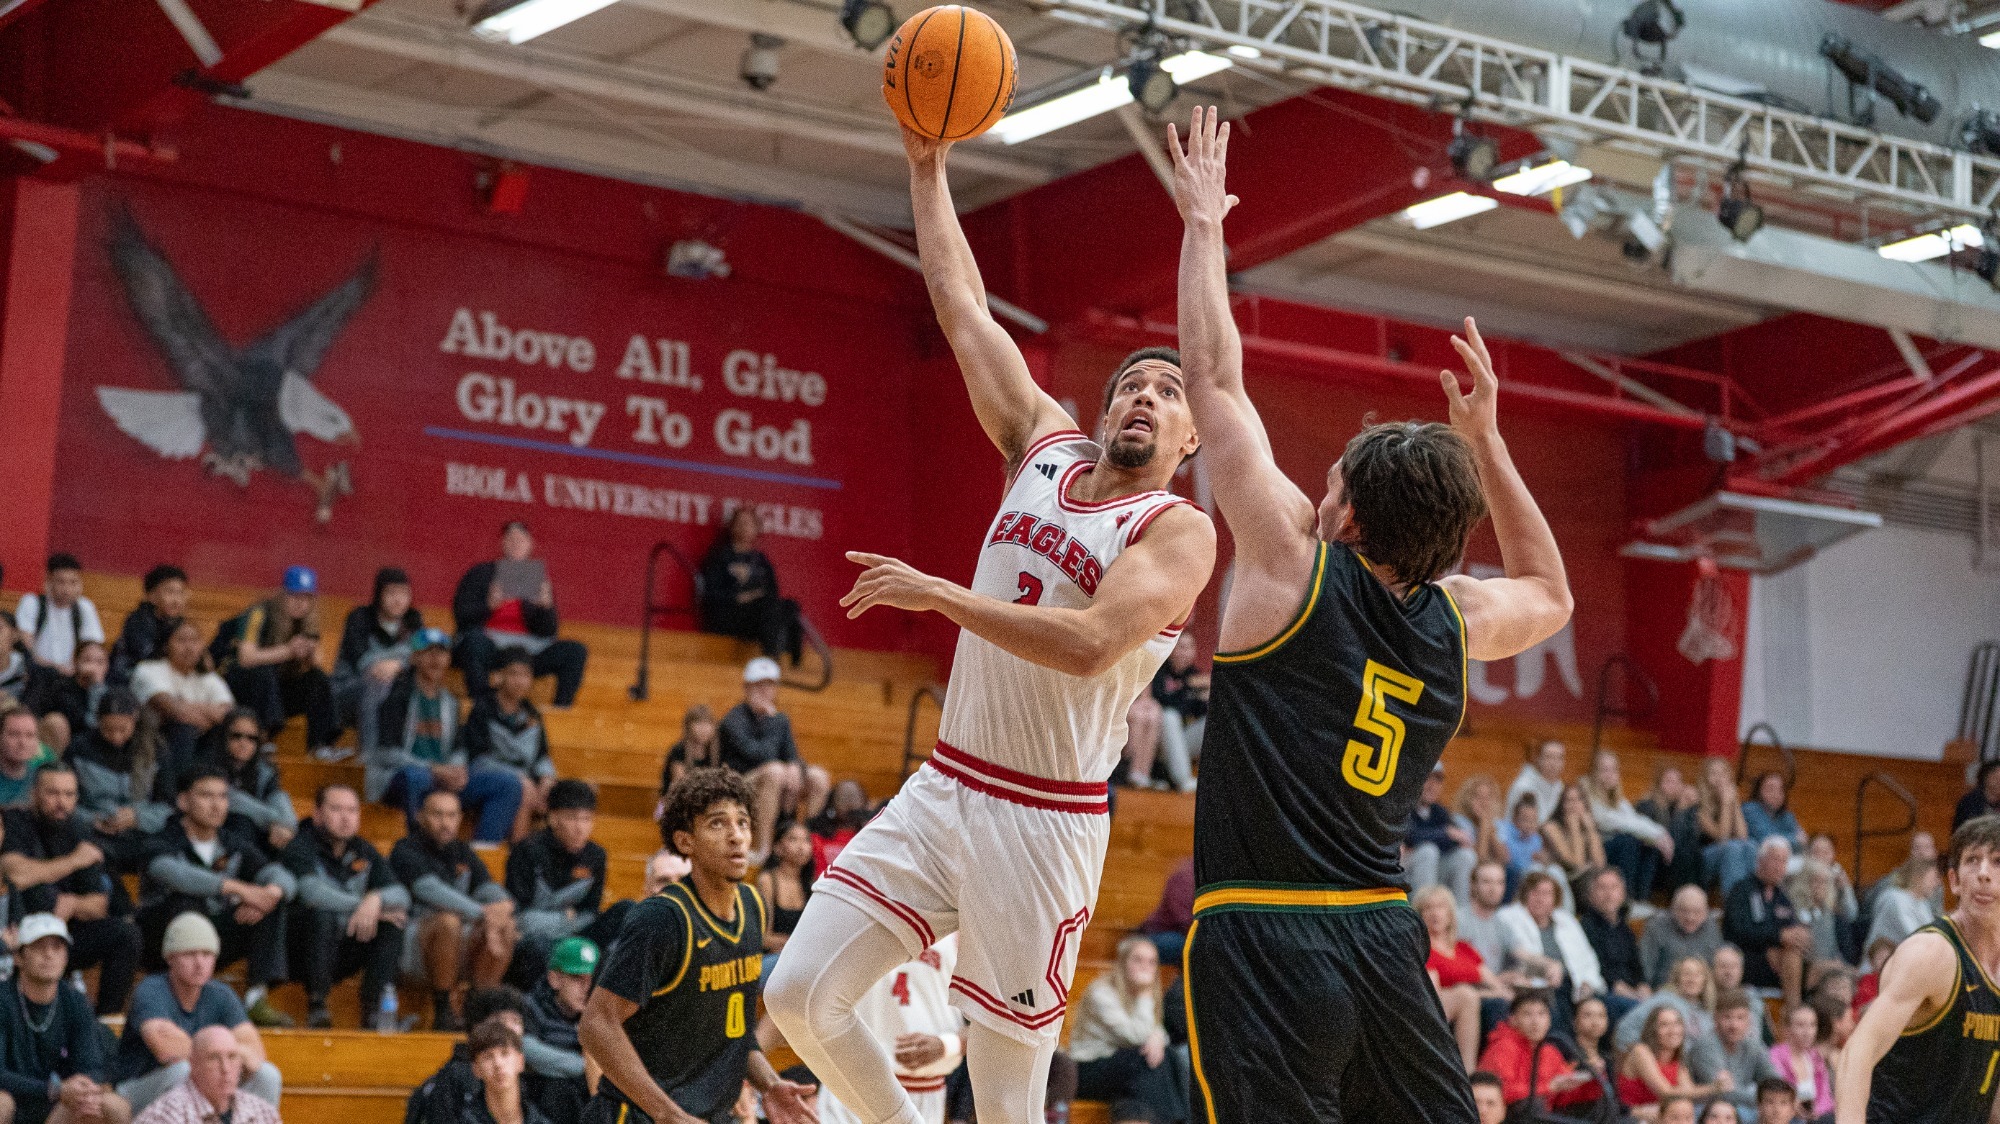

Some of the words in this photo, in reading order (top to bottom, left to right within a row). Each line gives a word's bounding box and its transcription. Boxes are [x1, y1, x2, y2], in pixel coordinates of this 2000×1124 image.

[440, 308, 597, 373] Above
[723, 349, 827, 407] Give
[456, 371, 605, 447] Glory
[625, 395, 693, 448] To
[714, 408, 813, 466] God
[446, 463, 533, 503] BIOLA
[544, 473, 712, 525] UNIVERSITY
[988, 511, 1102, 598] EAGLES
[1341, 659, 1424, 797] 5
[699, 960, 737, 993] POINT
[891, 971, 911, 1007] 4
[725, 992, 746, 1038] 0
